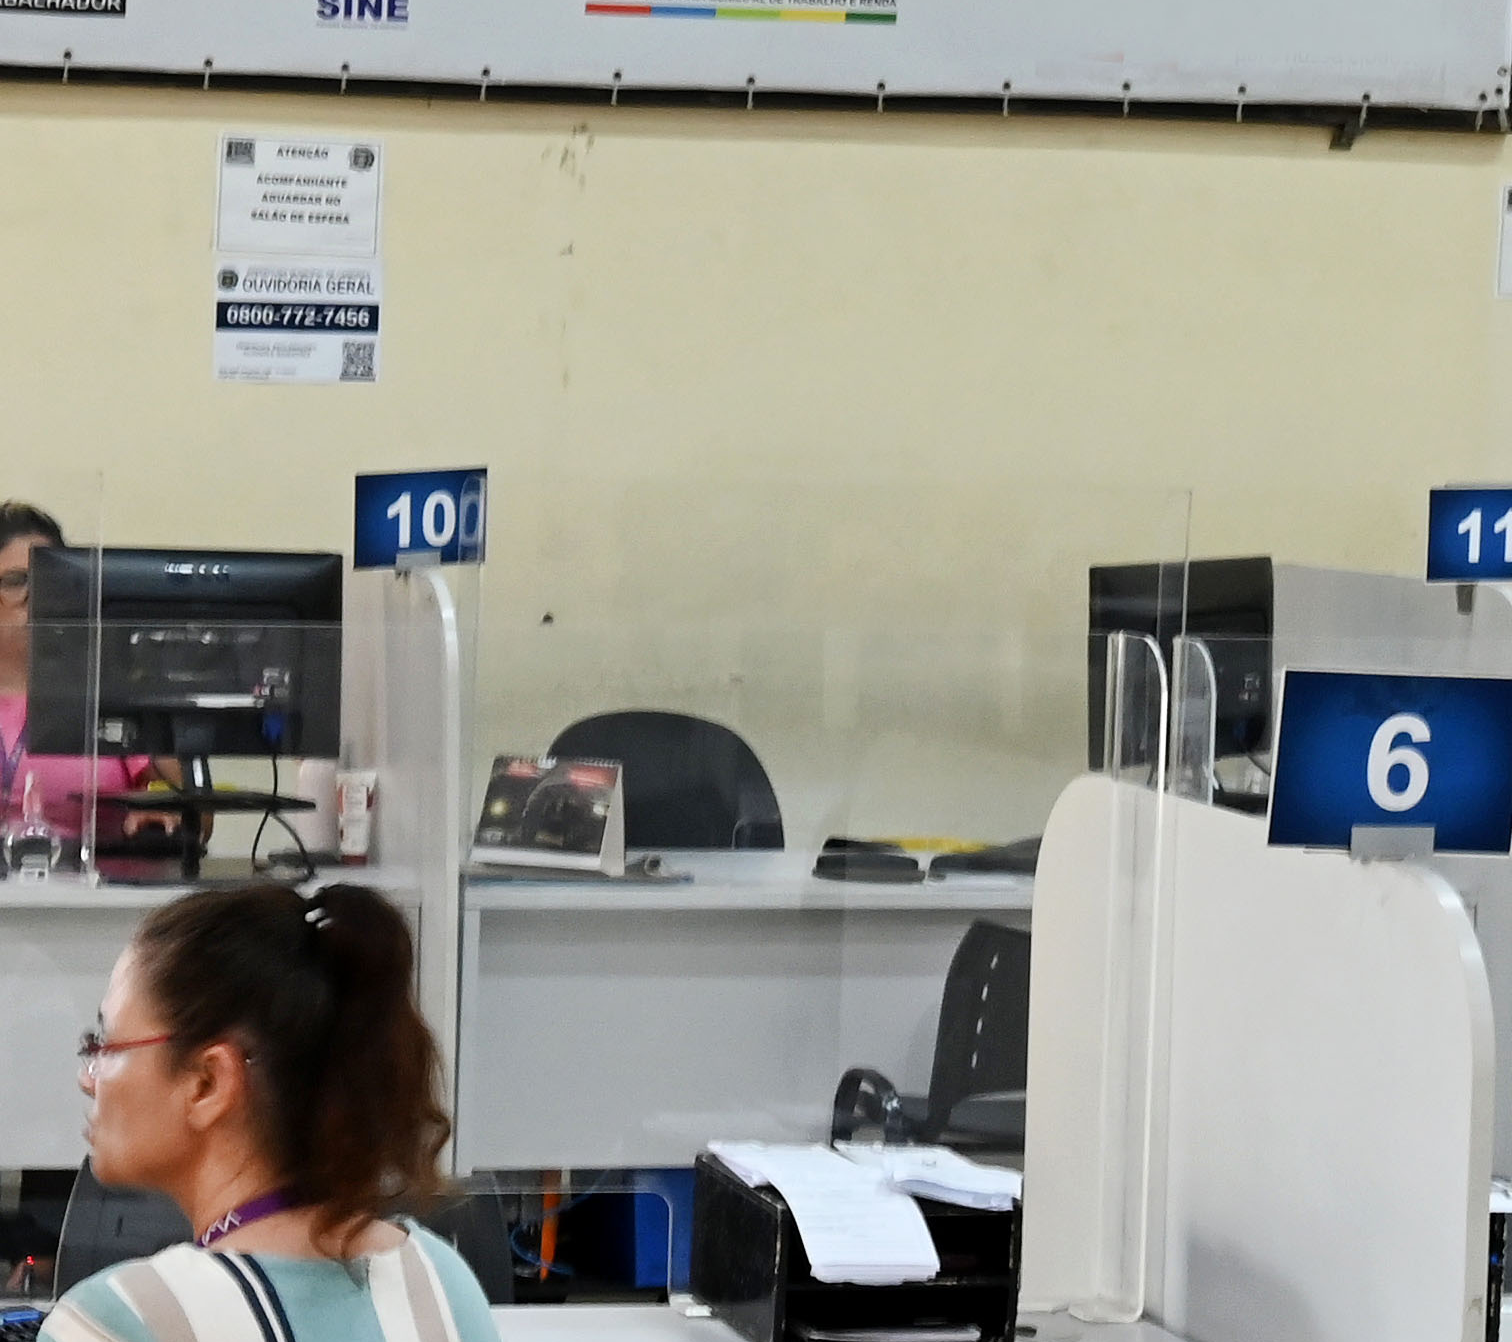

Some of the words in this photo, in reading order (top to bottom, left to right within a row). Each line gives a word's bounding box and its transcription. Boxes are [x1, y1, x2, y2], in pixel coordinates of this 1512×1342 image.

[242, 276, 322, 294] OUVIDORIA
[326, 278, 375, 296] GERAL
[1366, 712, 1432, 812] 6
